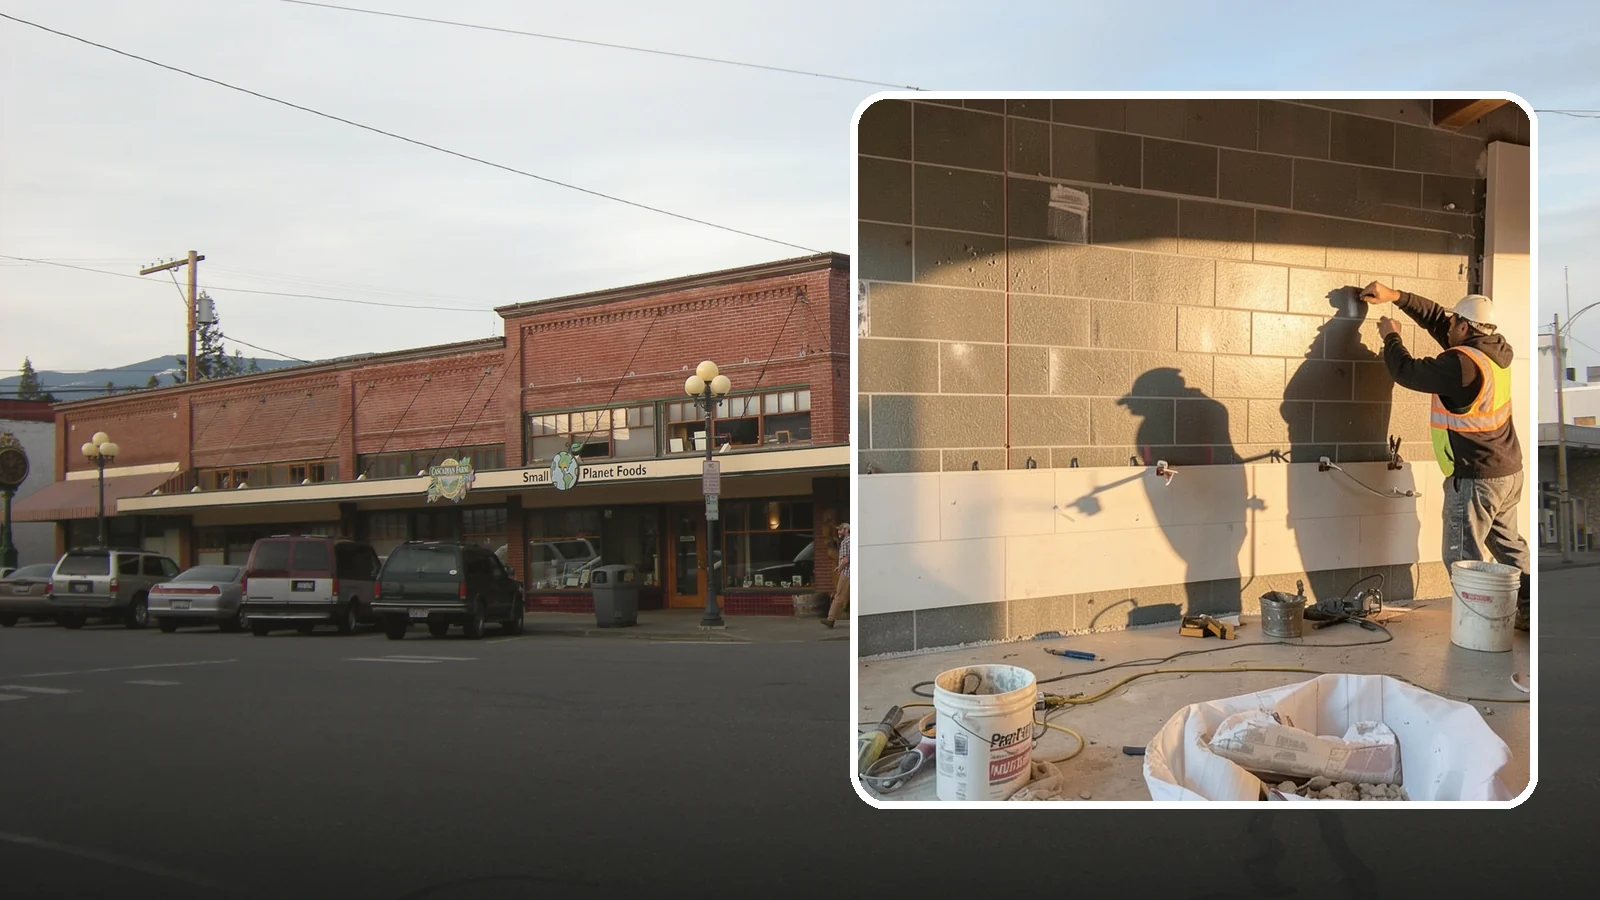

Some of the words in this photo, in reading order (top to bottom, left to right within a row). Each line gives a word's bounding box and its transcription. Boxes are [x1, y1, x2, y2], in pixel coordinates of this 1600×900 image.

[523, 471, 549, 483] Small
[583, 467, 614, 479] Planet
[617, 463, 647, 477] Foods
